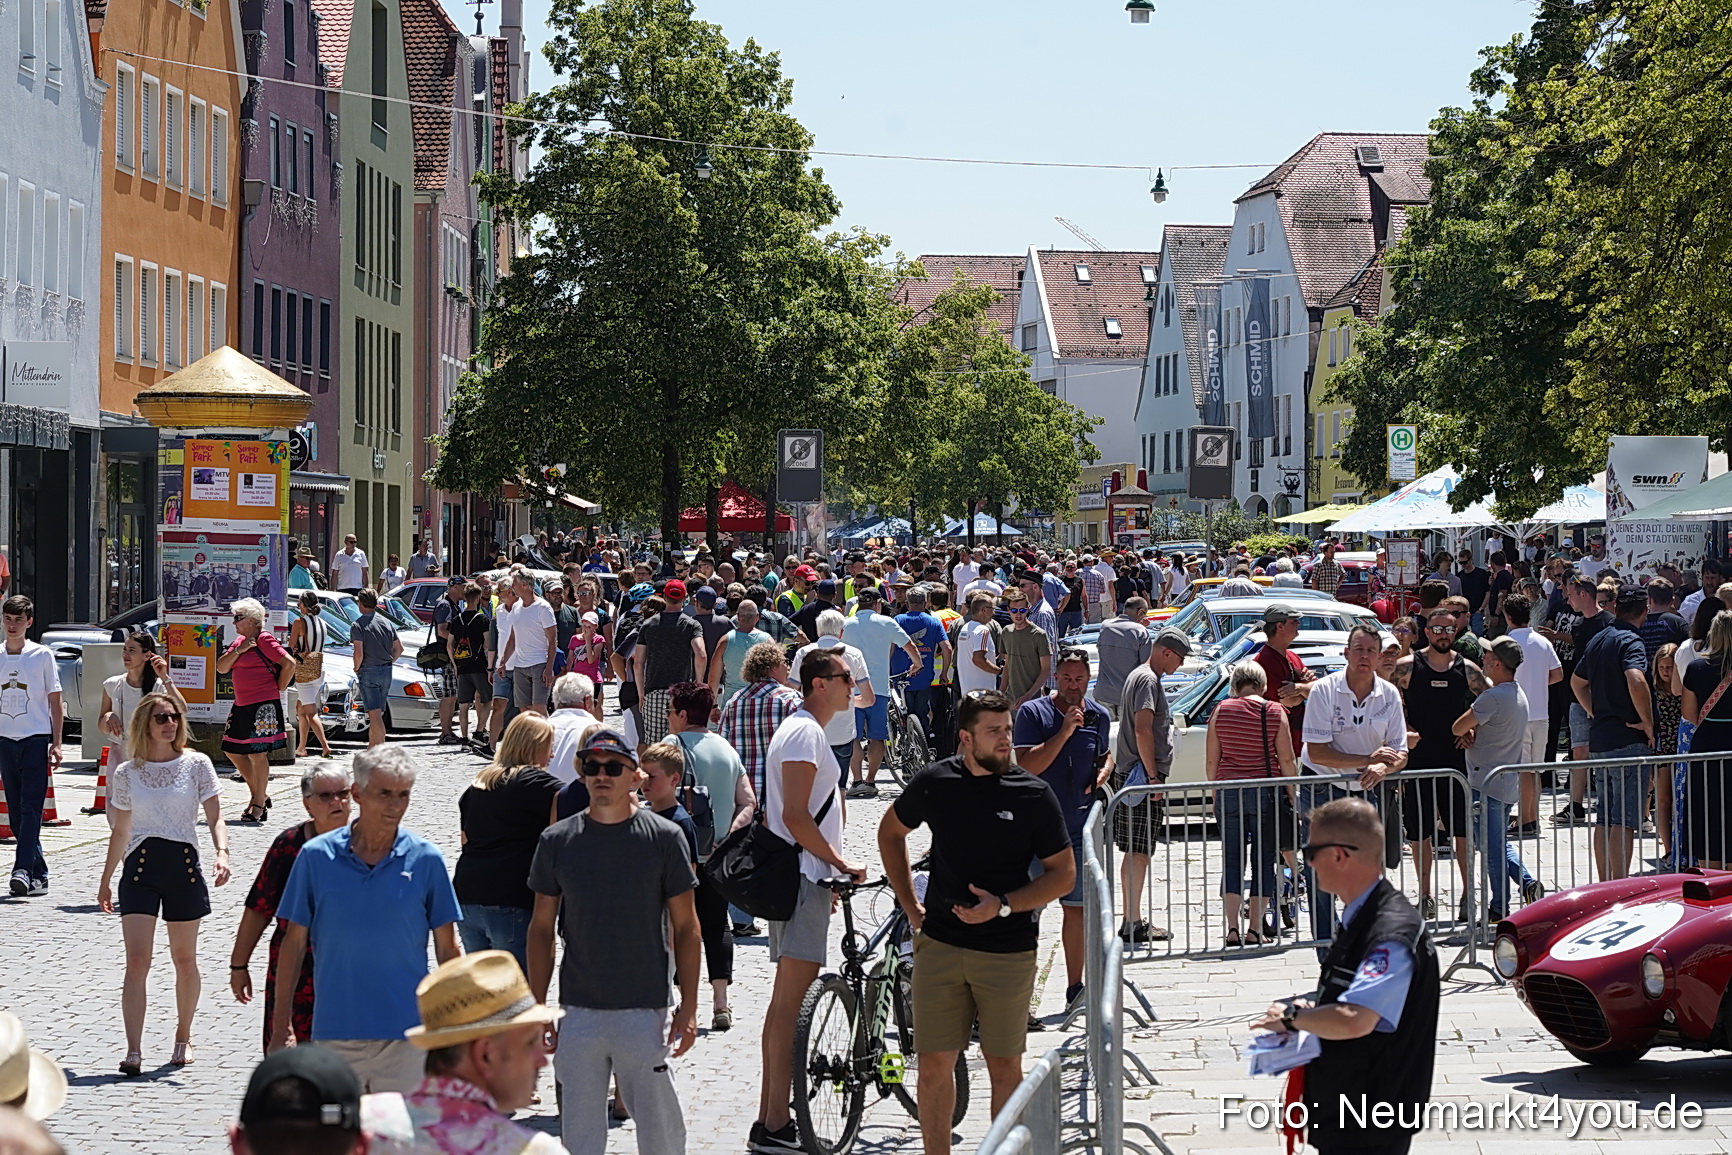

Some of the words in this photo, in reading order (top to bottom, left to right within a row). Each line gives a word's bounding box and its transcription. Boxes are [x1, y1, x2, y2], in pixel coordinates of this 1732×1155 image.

[1250, 320, 1262, 397] SCHMID
[12, 362, 63, 382] Mittendrin
[193, 451, 213, 462] Park
[239, 453, 259, 464] Park
[1631, 475, 1668, 485] swn
[1615, 524, 1635, 534] DEINE
[1636, 524, 1664, 534] STADT.
[1666, 524, 1685, 534] DEIN
[1626, 535, 1644, 544] DEIN
[1645, 535, 1696, 545] STADTWERK!
[217, 683, 234, 695] Lic
[1567, 919, 1646, 951] 124
